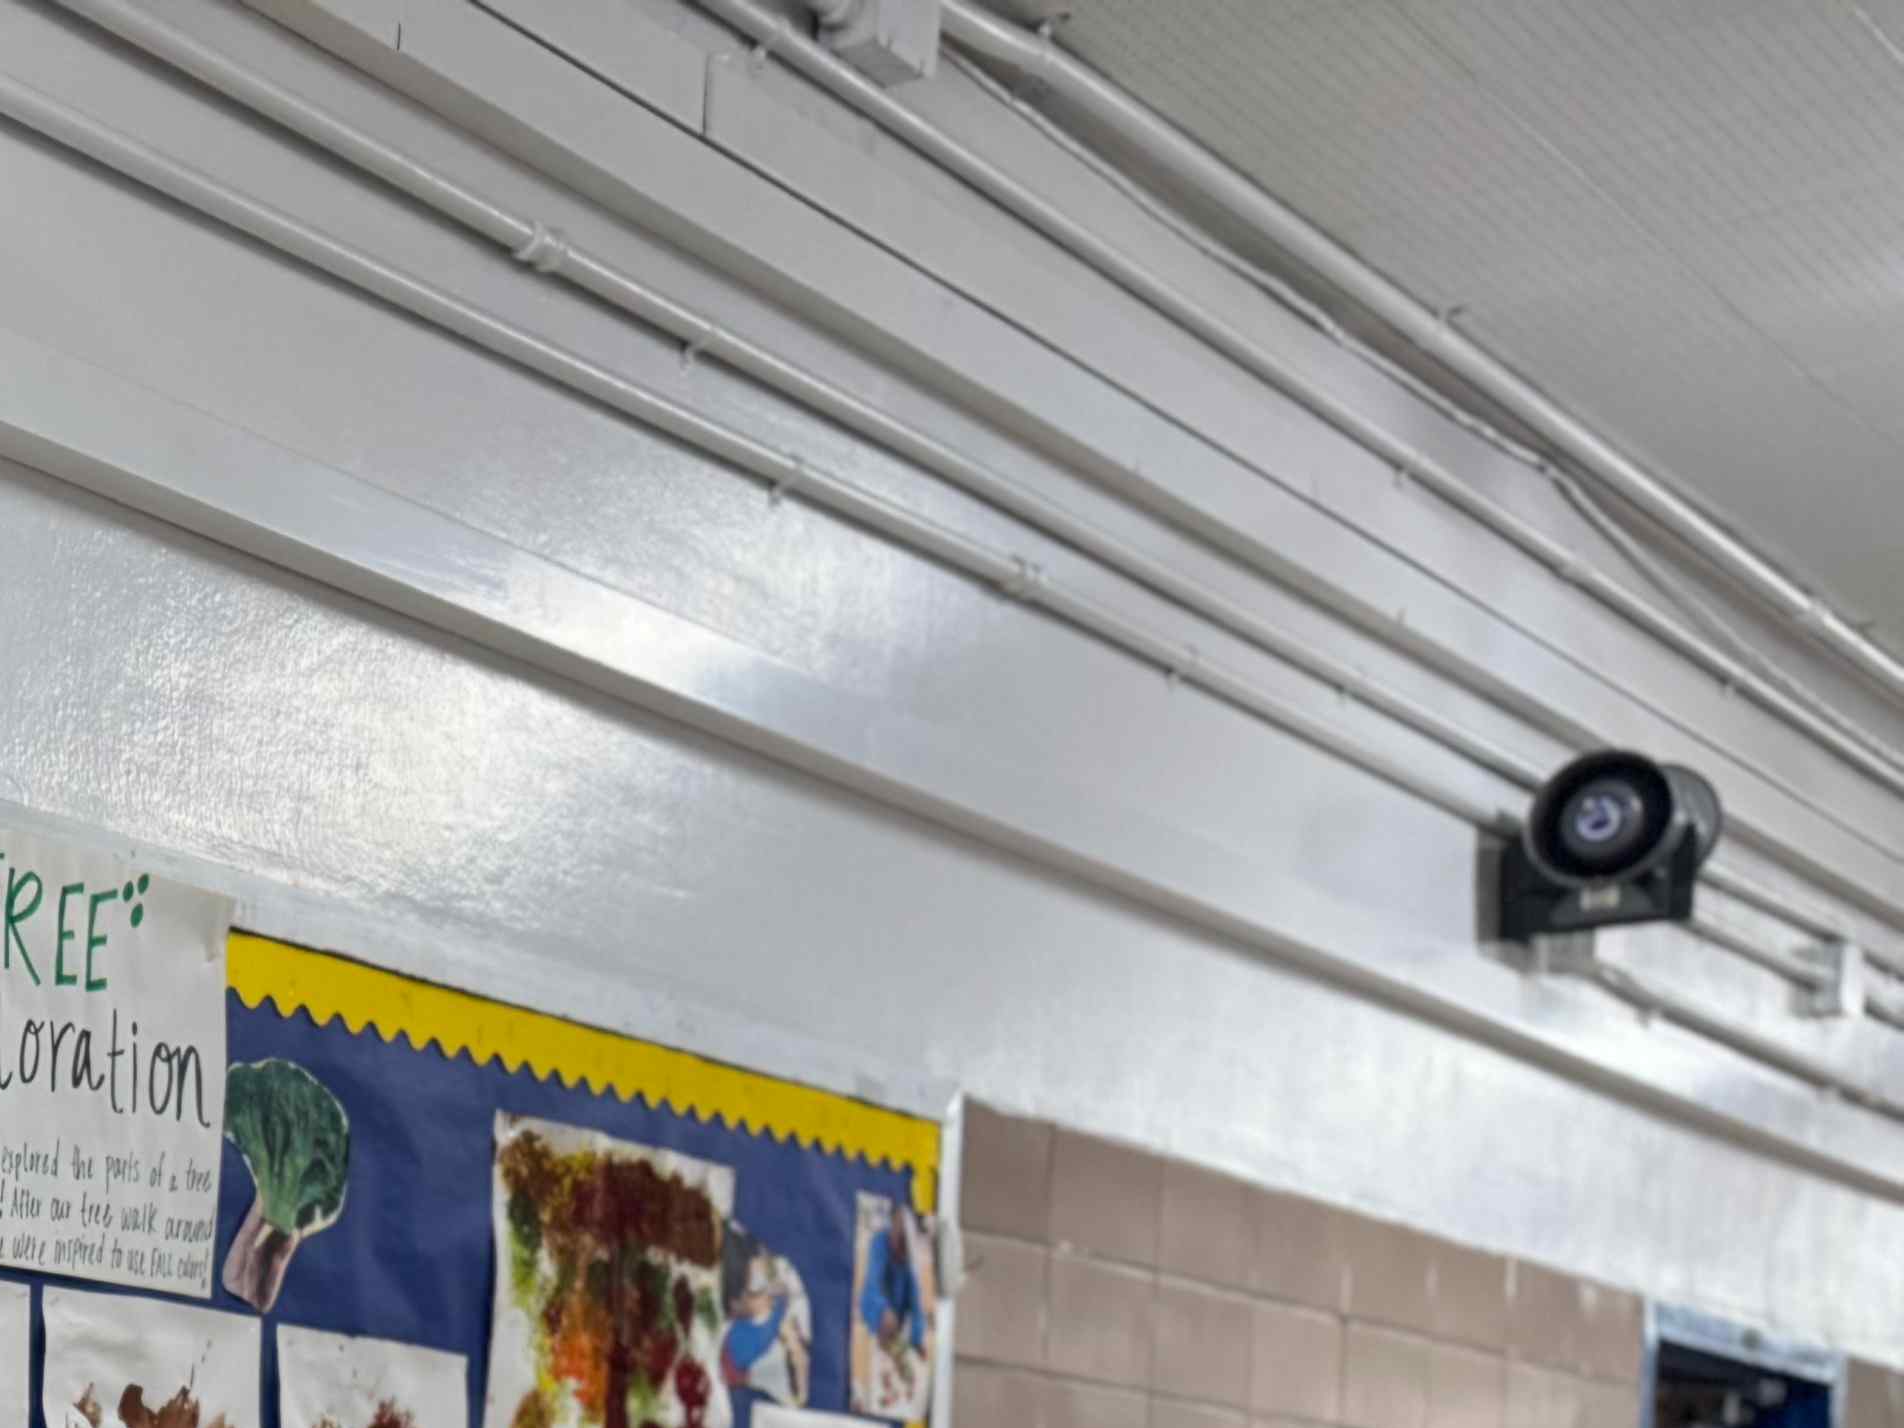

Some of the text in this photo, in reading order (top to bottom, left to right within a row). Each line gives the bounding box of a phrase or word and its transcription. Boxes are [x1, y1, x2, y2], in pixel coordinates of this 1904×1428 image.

[1, 1137, 60, 1183] explored
[72, 1144, 93, 1181] the
[105, 1151, 141, 1195] parts
[149, 1151, 166, 1188] of
[168, 1173, 178, 1193] a
[185, 1157, 212, 1193] tree
[10, 1186, 42, 1219] After
[50, 1197, 71, 1222] our
[80, 1191, 113, 1229] tree
[121, 1202, 158, 1234] walk
[164, 1207, 215, 1243] around
[12, 1232, 46, 1267] were
[53, 1232, 106, 1271] inspired
[111, 1237, 123, 1269] to
[127, 1248, 144, 1276] use
